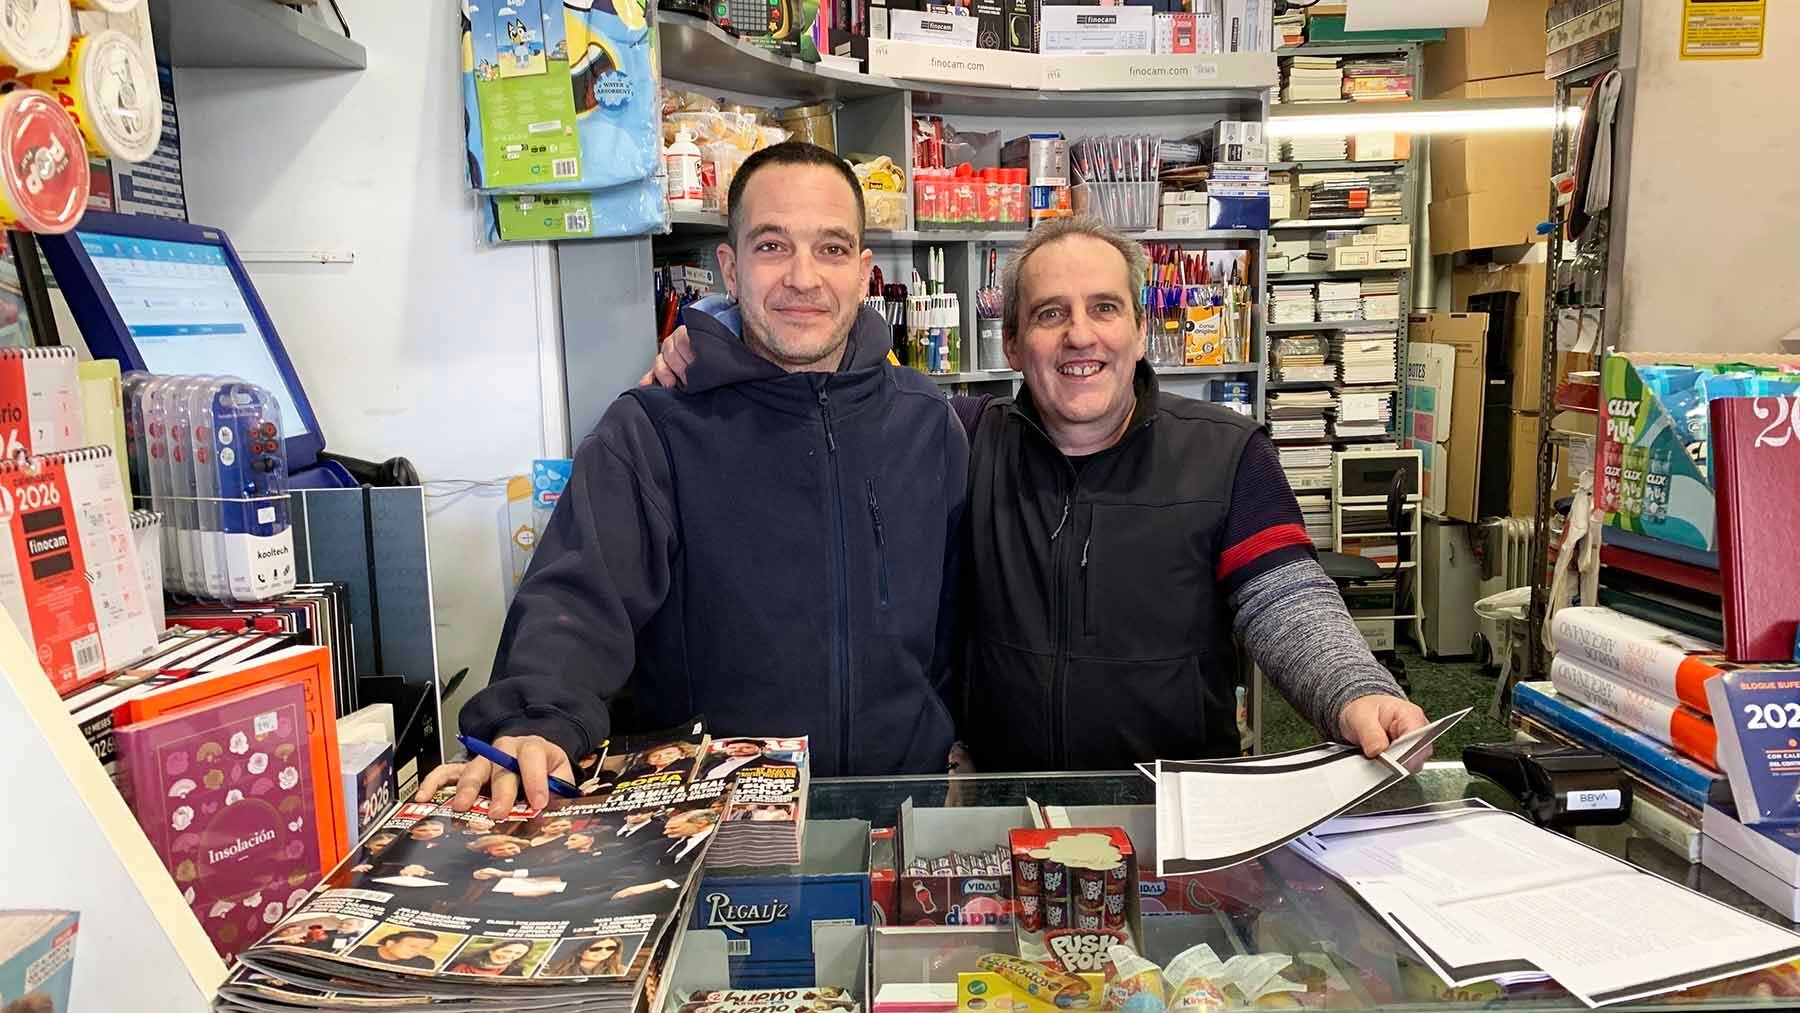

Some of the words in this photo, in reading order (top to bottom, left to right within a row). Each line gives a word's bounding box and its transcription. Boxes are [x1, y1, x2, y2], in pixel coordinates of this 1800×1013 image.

[928, 21, 954, 32] finocam
[1085, 14, 1117, 25] finocam
[931, 57, 985, 72] finocam.com
[1129, 65, 1189, 77] finocam.com
[1607, 399, 1641, 418] CLIX
[1753, 393, 1800, 448] 2
[1606, 419, 1636, 444] PLUS
[1603, 465, 1621, 477] CLIX
[1623, 469, 1642, 481] CLIX
[1646, 473, 1666, 486] CLIX
[16, 482, 61, 511] 2026
[29, 535, 68, 555] finocam
[257, 546, 289, 560] kooltech
[1740, 682, 1776, 690] BLOQUE
[628, 785, 686, 801] FAMILIA
[688, 779, 727, 792] REAL
[362, 780, 390, 826] 2026
[1580, 793, 1608, 802] BBVA
[208, 827, 276, 864] Insolación
[967, 882, 999, 891] VIDAL
[1138, 880, 1167, 894] IDAL
[1050, 934, 1120, 957] PUSH
[1061, 951, 1113, 973] POP
[722, 990, 799, 1003] bueno
